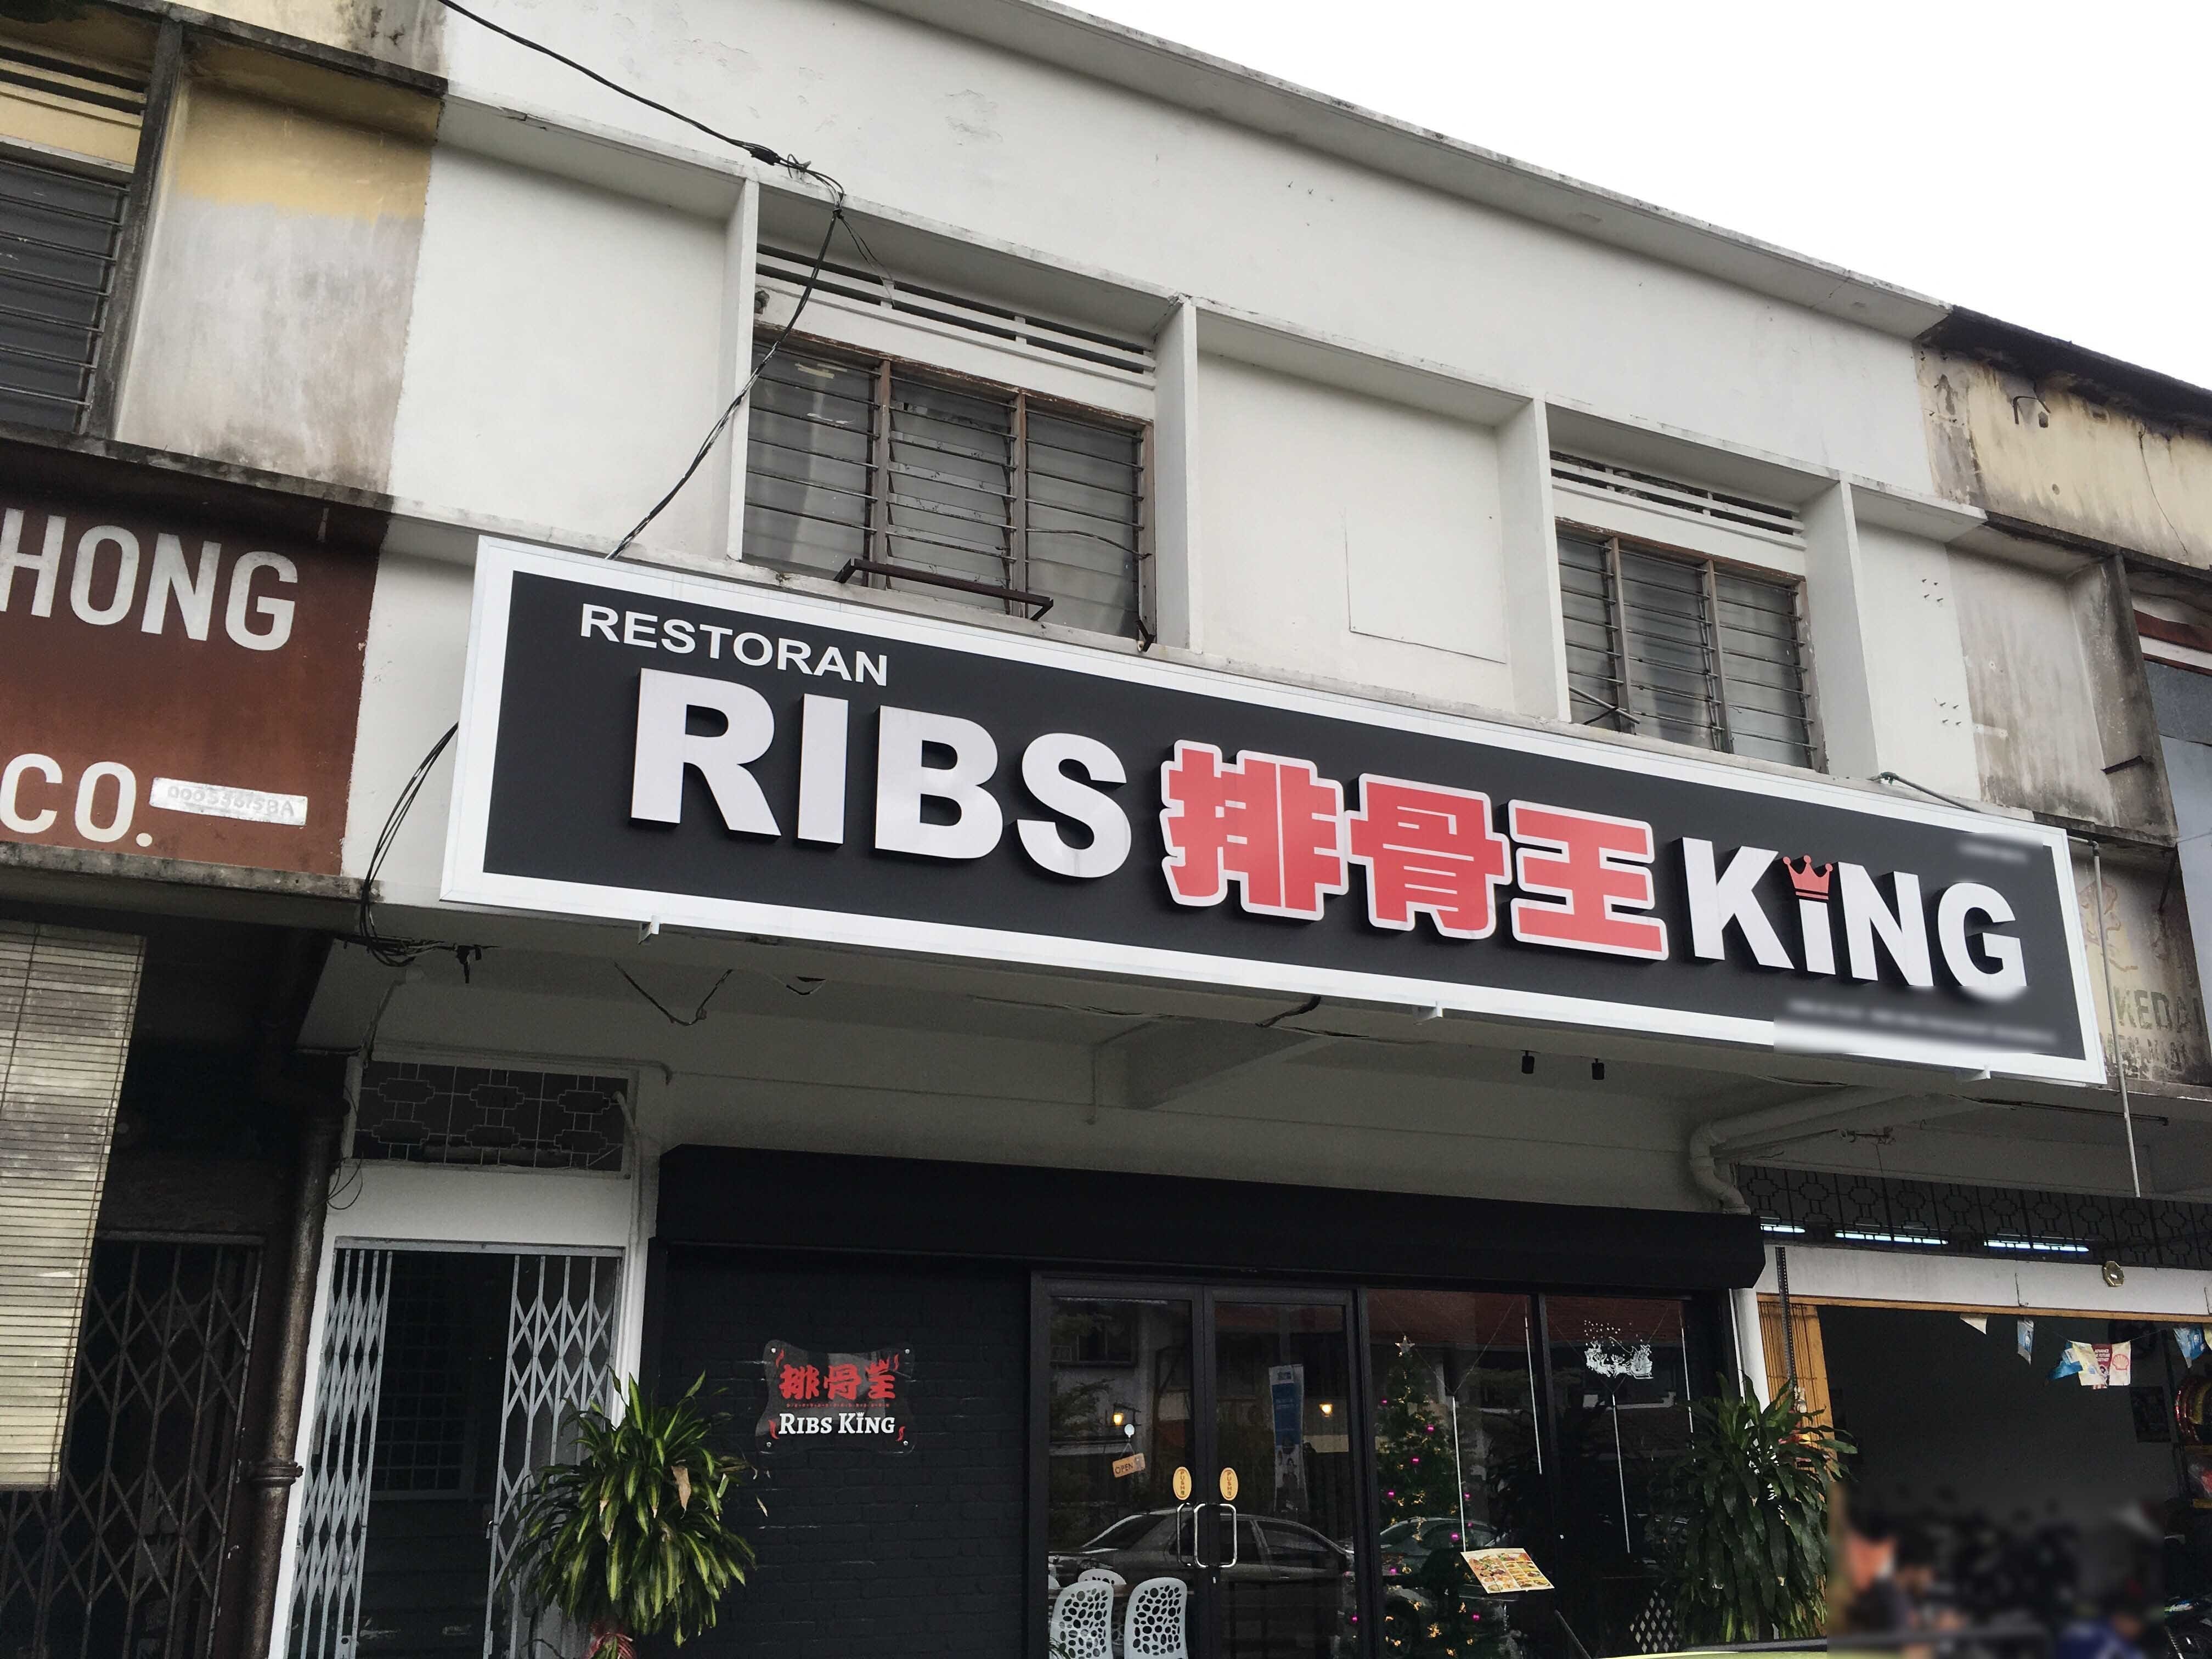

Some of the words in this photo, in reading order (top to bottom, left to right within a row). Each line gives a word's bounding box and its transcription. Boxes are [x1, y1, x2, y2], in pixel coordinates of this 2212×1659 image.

[0, 507, 298, 651] HONG
[579, 603, 888, 687] RESTORAN
[0, 753, 153, 848] CO.
[630, 668, 1132, 879] RIBS
[1161, 739, 1668, 961] 排骨王
[1114, 1463, 1133, 1475] OPEN
